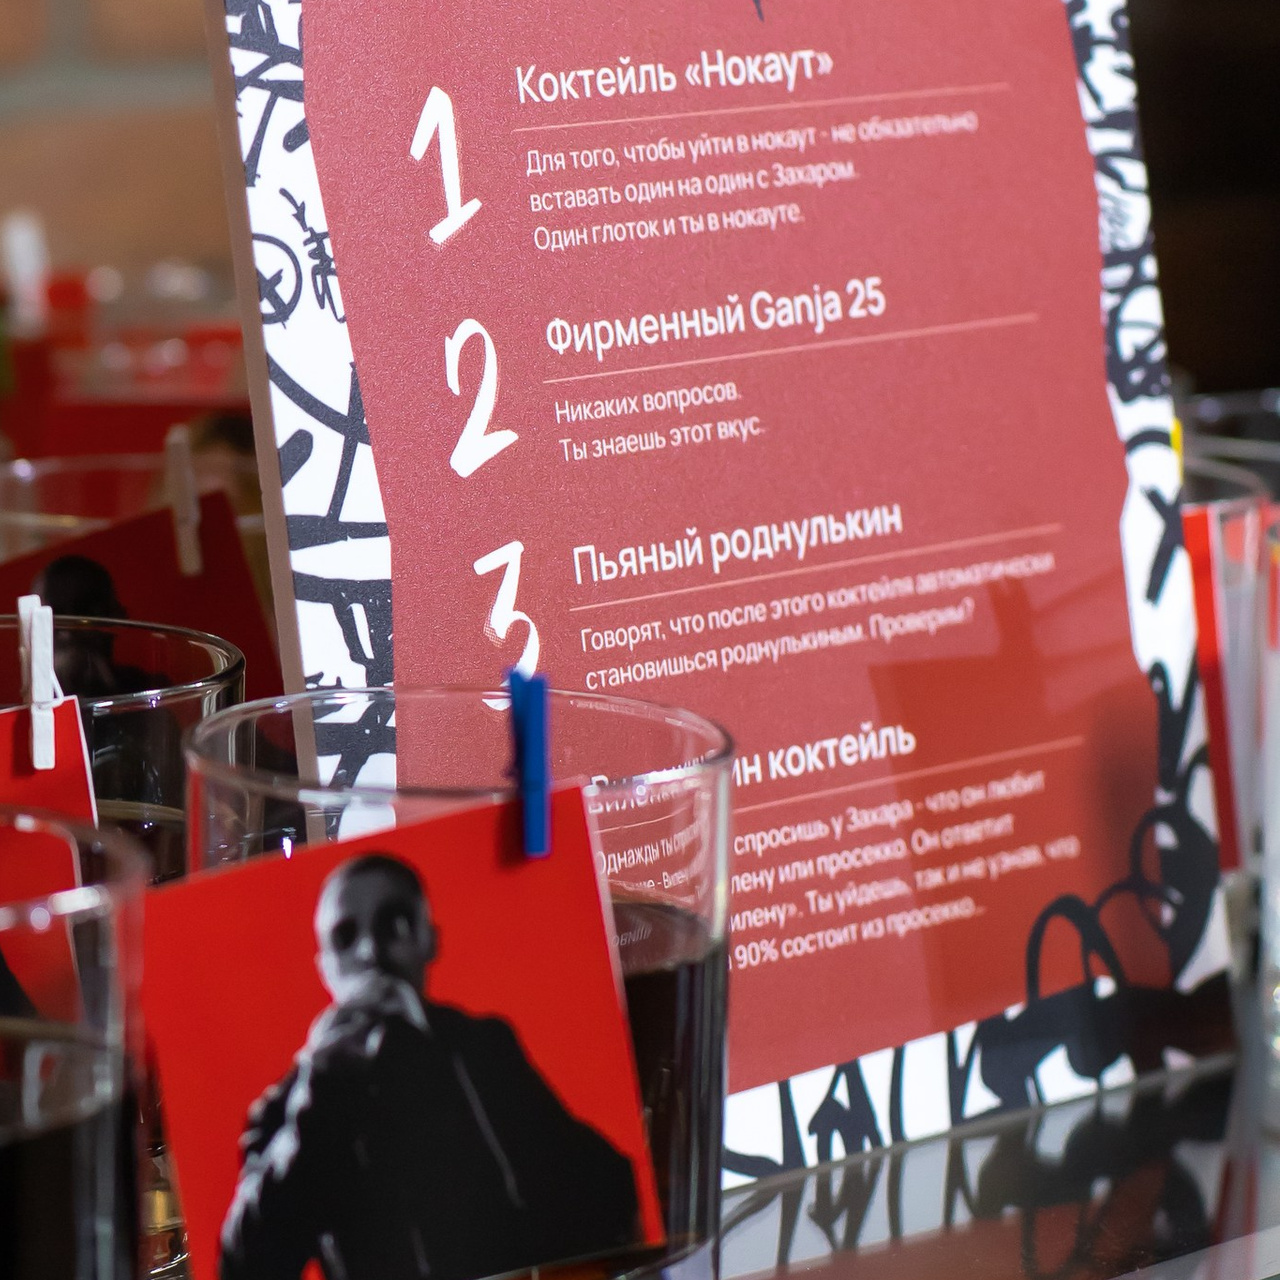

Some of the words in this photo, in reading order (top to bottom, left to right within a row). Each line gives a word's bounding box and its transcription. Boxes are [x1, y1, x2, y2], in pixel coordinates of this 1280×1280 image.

[516, 56, 677, 104] Коктейль
[685, 49, 834, 93] «Нокаут»
[410, 86, 482, 248] 1
[526, 149, 566, 178] Для
[570, 147, 620, 170] того,
[624, 136, 686, 163] чтобы
[688, 132, 735, 164] уйти
[737, 134, 749, 153] в
[751, 125, 817, 154] нокаут
[830, 122, 857, 144] не
[529, 186, 622, 213] вставать
[624, 179, 675, 204] один
[677, 176, 703, 198] на
[705, 170, 755, 196] один
[756, 168, 770, 189] с
[771, 160, 861, 189] Захаром.
[534, 226, 589, 253] Один
[592, 219, 661, 244] глоток
[663, 216, 676, 237] и
[678, 213, 704, 235] ты
[707, 211, 721, 232] в
[722, 202, 805, 231] нокауте.
[546, 293, 746, 362] Фирменный
[749, 283, 843, 335] Ganja
[845, 276, 887, 319] 25
[444, 318, 519, 478] 2
[555, 394, 640, 425] Никаких
[642, 381, 743, 414] вопросов.
[559, 437, 588, 463] Ты
[591, 427, 667, 458] знаешь
[669, 421, 713, 448] этот
[717, 415, 766, 445] вкус.
[573, 527, 704, 586] Пьяный
[709, 503, 904, 575] роднулькин
[580, 620, 667, 652] Говорят,
[669, 614, 705, 635] что
[707, 601, 767, 632] после
[770, 591, 826, 621] этого
[827, 575, 915, 610] коктейля
[585, 648, 719, 691] становишься
[721, 622, 868, 673] роднулькиным.
[869, 596, 975, 644] Проверим?
[768, 720, 917, 780] коктейль
[733, 818, 831, 858] спросишь
[830, 814, 844, 841] у
[846, 798, 915, 832] Захара
[924, 789, 961, 814] что
[961, 783, 987, 809] он
[987, 770, 1046, 801] любит
[778, 858, 816, 885] или
[911, 828, 941, 856] Он
[941, 813, 1015, 850] ответит
[805, 888, 834, 915] Ты
[915, 867, 946, 892] так
[946, 861, 961, 883] и
[961, 856, 988, 880] не
[1044, 834, 1082, 860] что
[734, 936, 780, 971] 90%
[780, 922, 858, 960] состоит
[861, 917, 885, 940] из
